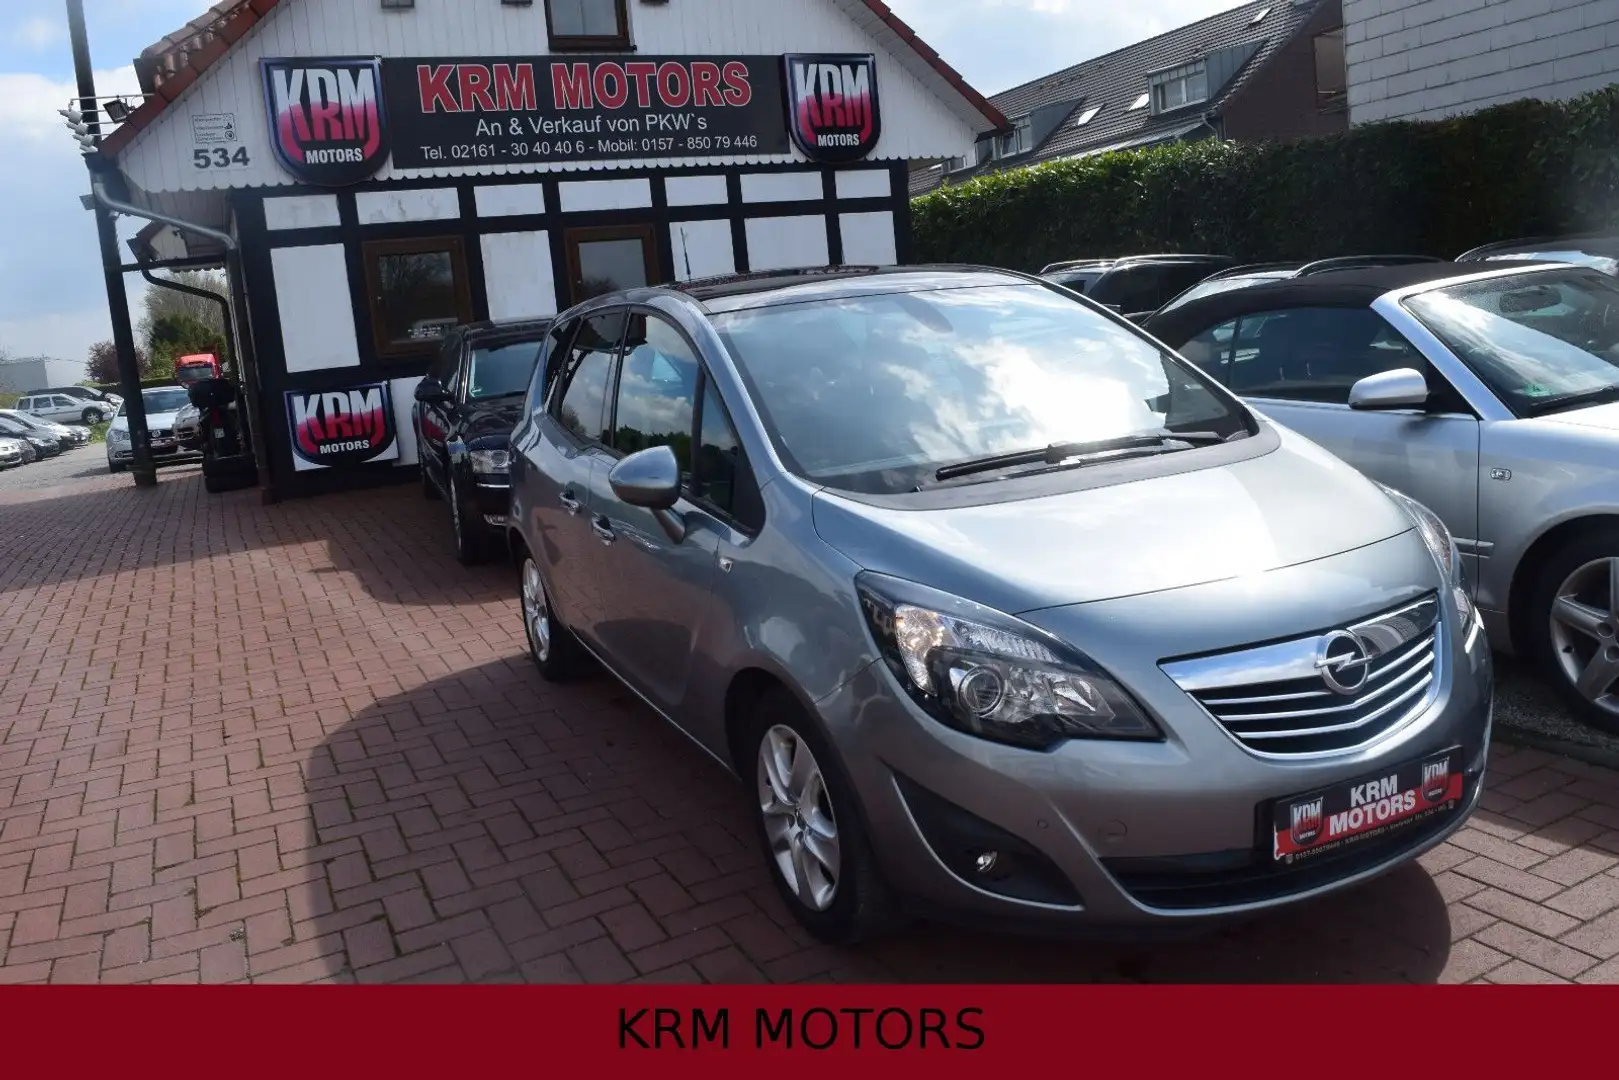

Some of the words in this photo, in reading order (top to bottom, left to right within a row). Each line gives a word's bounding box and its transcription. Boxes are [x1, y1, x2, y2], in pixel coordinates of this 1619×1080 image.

[417, 63, 537, 113] KRM
[550, 61, 752, 109] MOTORS
[273, 68, 380, 160] KRM
[795, 63, 873, 143] KRM
[476, 118, 502, 136] An
[509, 117, 523, 135] &
[528, 115, 601, 135] Verkauf
[607, 117, 640, 132] von
[817, 133, 860, 147] MOTORS
[194, 146, 250, 169] 534
[305, 147, 363, 165] MOTORS
[420, 145, 447, 160] Tel.
[451, 143, 495, 159] 02161
[511, 142, 528, 156] 30
[533, 141, 550, 155] 40
[554, 140, 572, 154] 40
[576, 140, 585, 154] 6
[598, 138, 638, 153] Mobil:
[641, 137, 674, 152] 0157
[687, 136, 711, 150] 850
[715, 135, 731, 149] 79
[734, 135, 758, 148] 446
[293, 388, 385, 454] KRM
[319, 440, 370, 455] MOTORS
[1350, 774, 1398, 808] KRM
[1329, 789, 1416, 836] MOTORS
